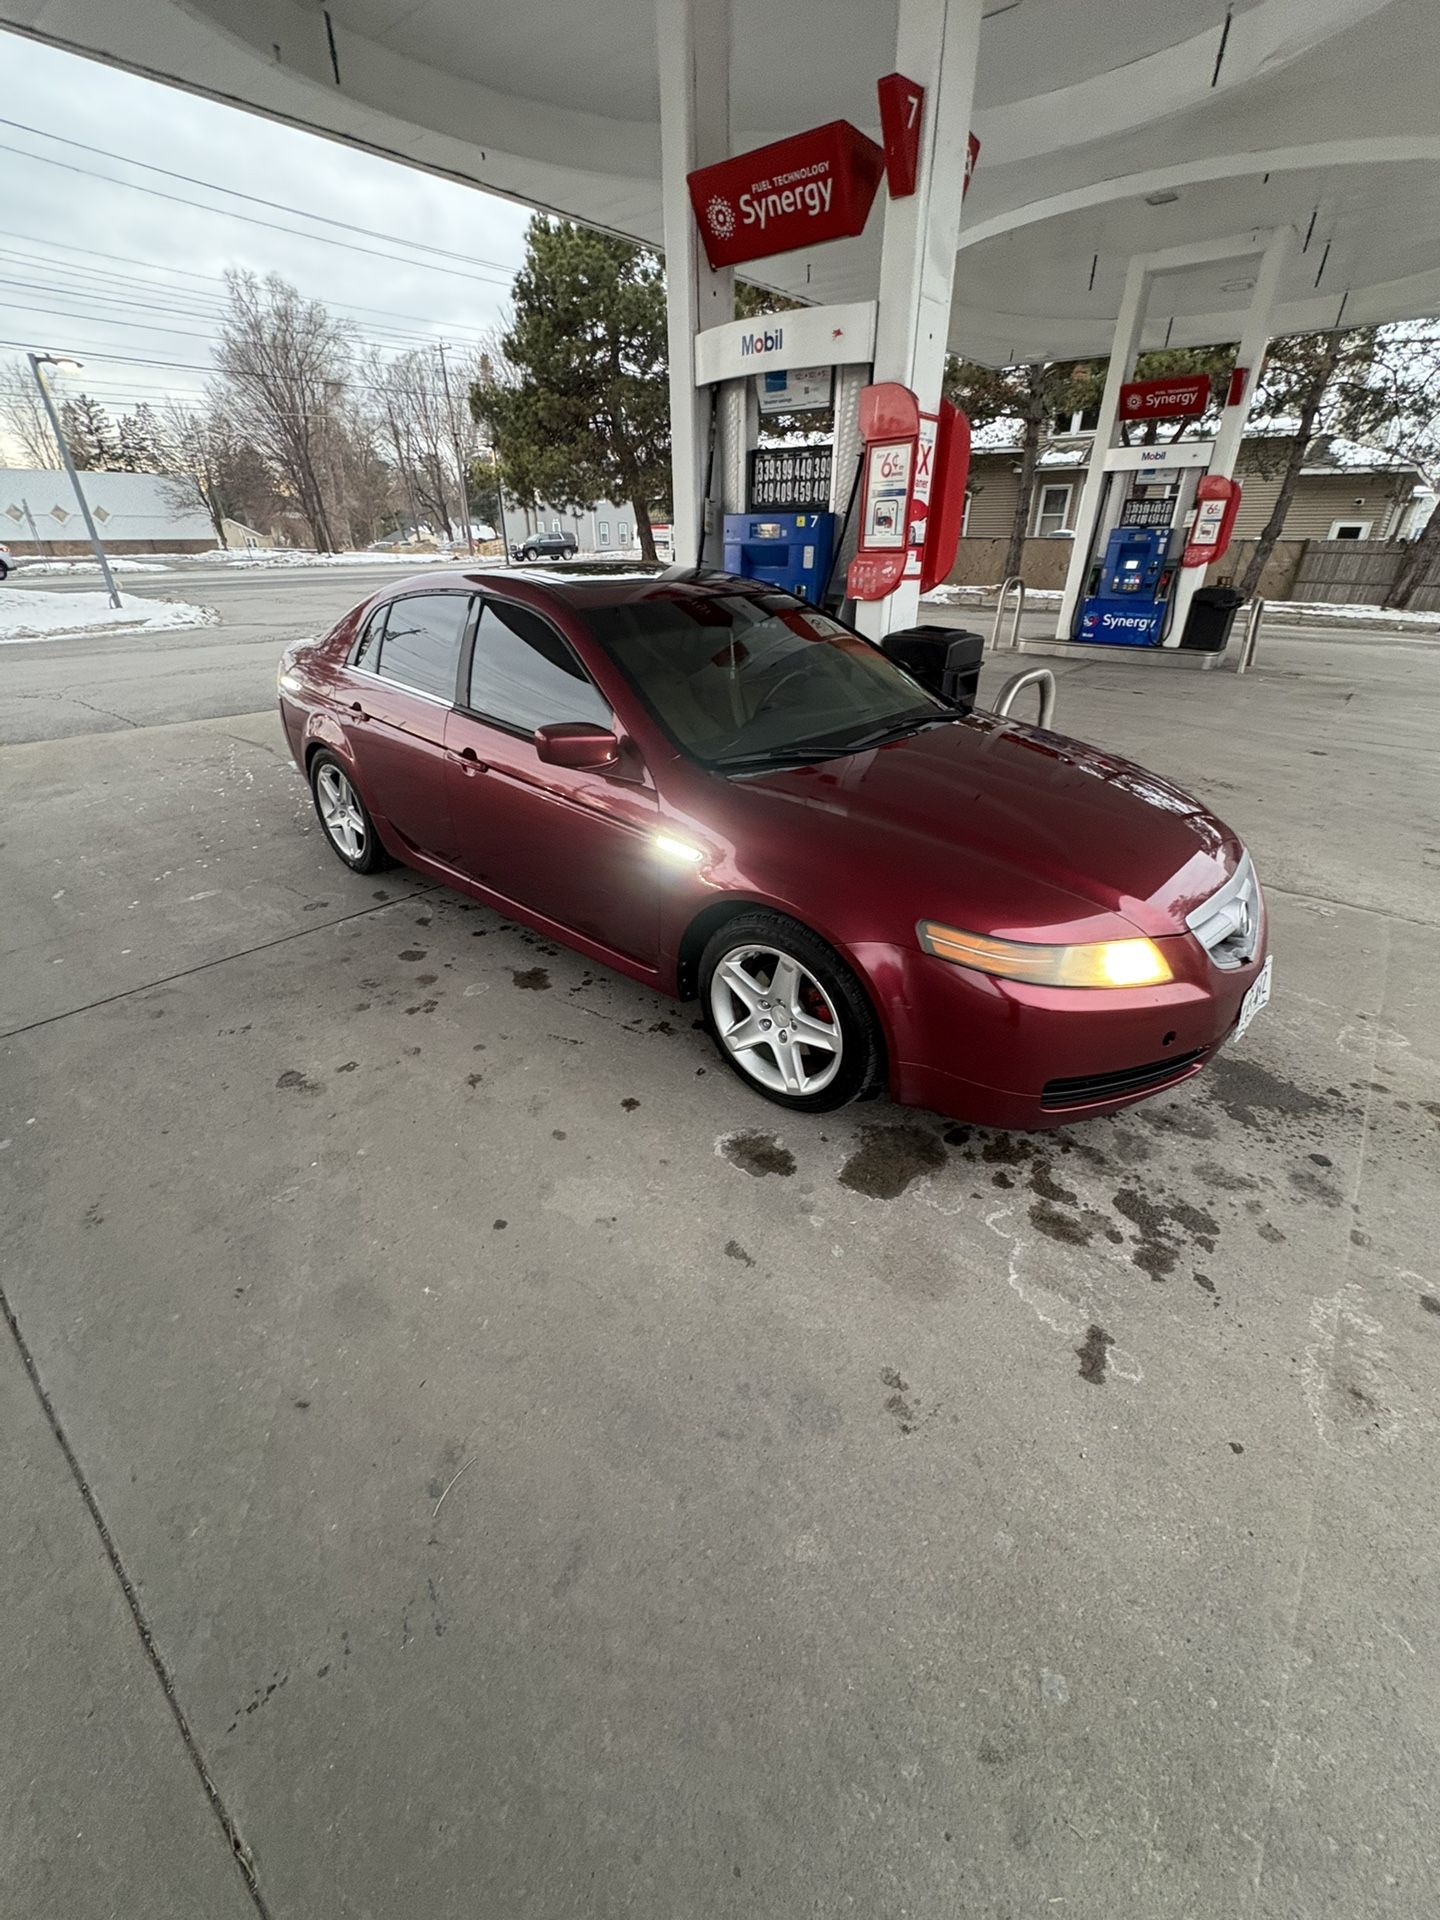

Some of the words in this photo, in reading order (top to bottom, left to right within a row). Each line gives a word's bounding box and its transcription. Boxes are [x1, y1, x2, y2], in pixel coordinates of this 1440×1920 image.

[907, 95, 918, 129] 7
[751, 180, 772, 194] FUEL
[772, 160, 829, 187] TECHNOLOGY
[739, 177, 833, 230] Synergy
[741, 328, 783, 356] Mobil
[1145, 391, 1199, 409] Synergy
[1141, 451, 1167, 461] Mobil
[757, 459, 775, 481] 339
[776, 459, 793, 481] 399
[794, 458, 812, 480] 449
[757, 482, 774, 503] 349
[775, 481, 792, 503] 409
[793, 481, 811, 502] 459
[810, 515, 818, 528] 7
[1102, 613, 1157, 632] Synergy
